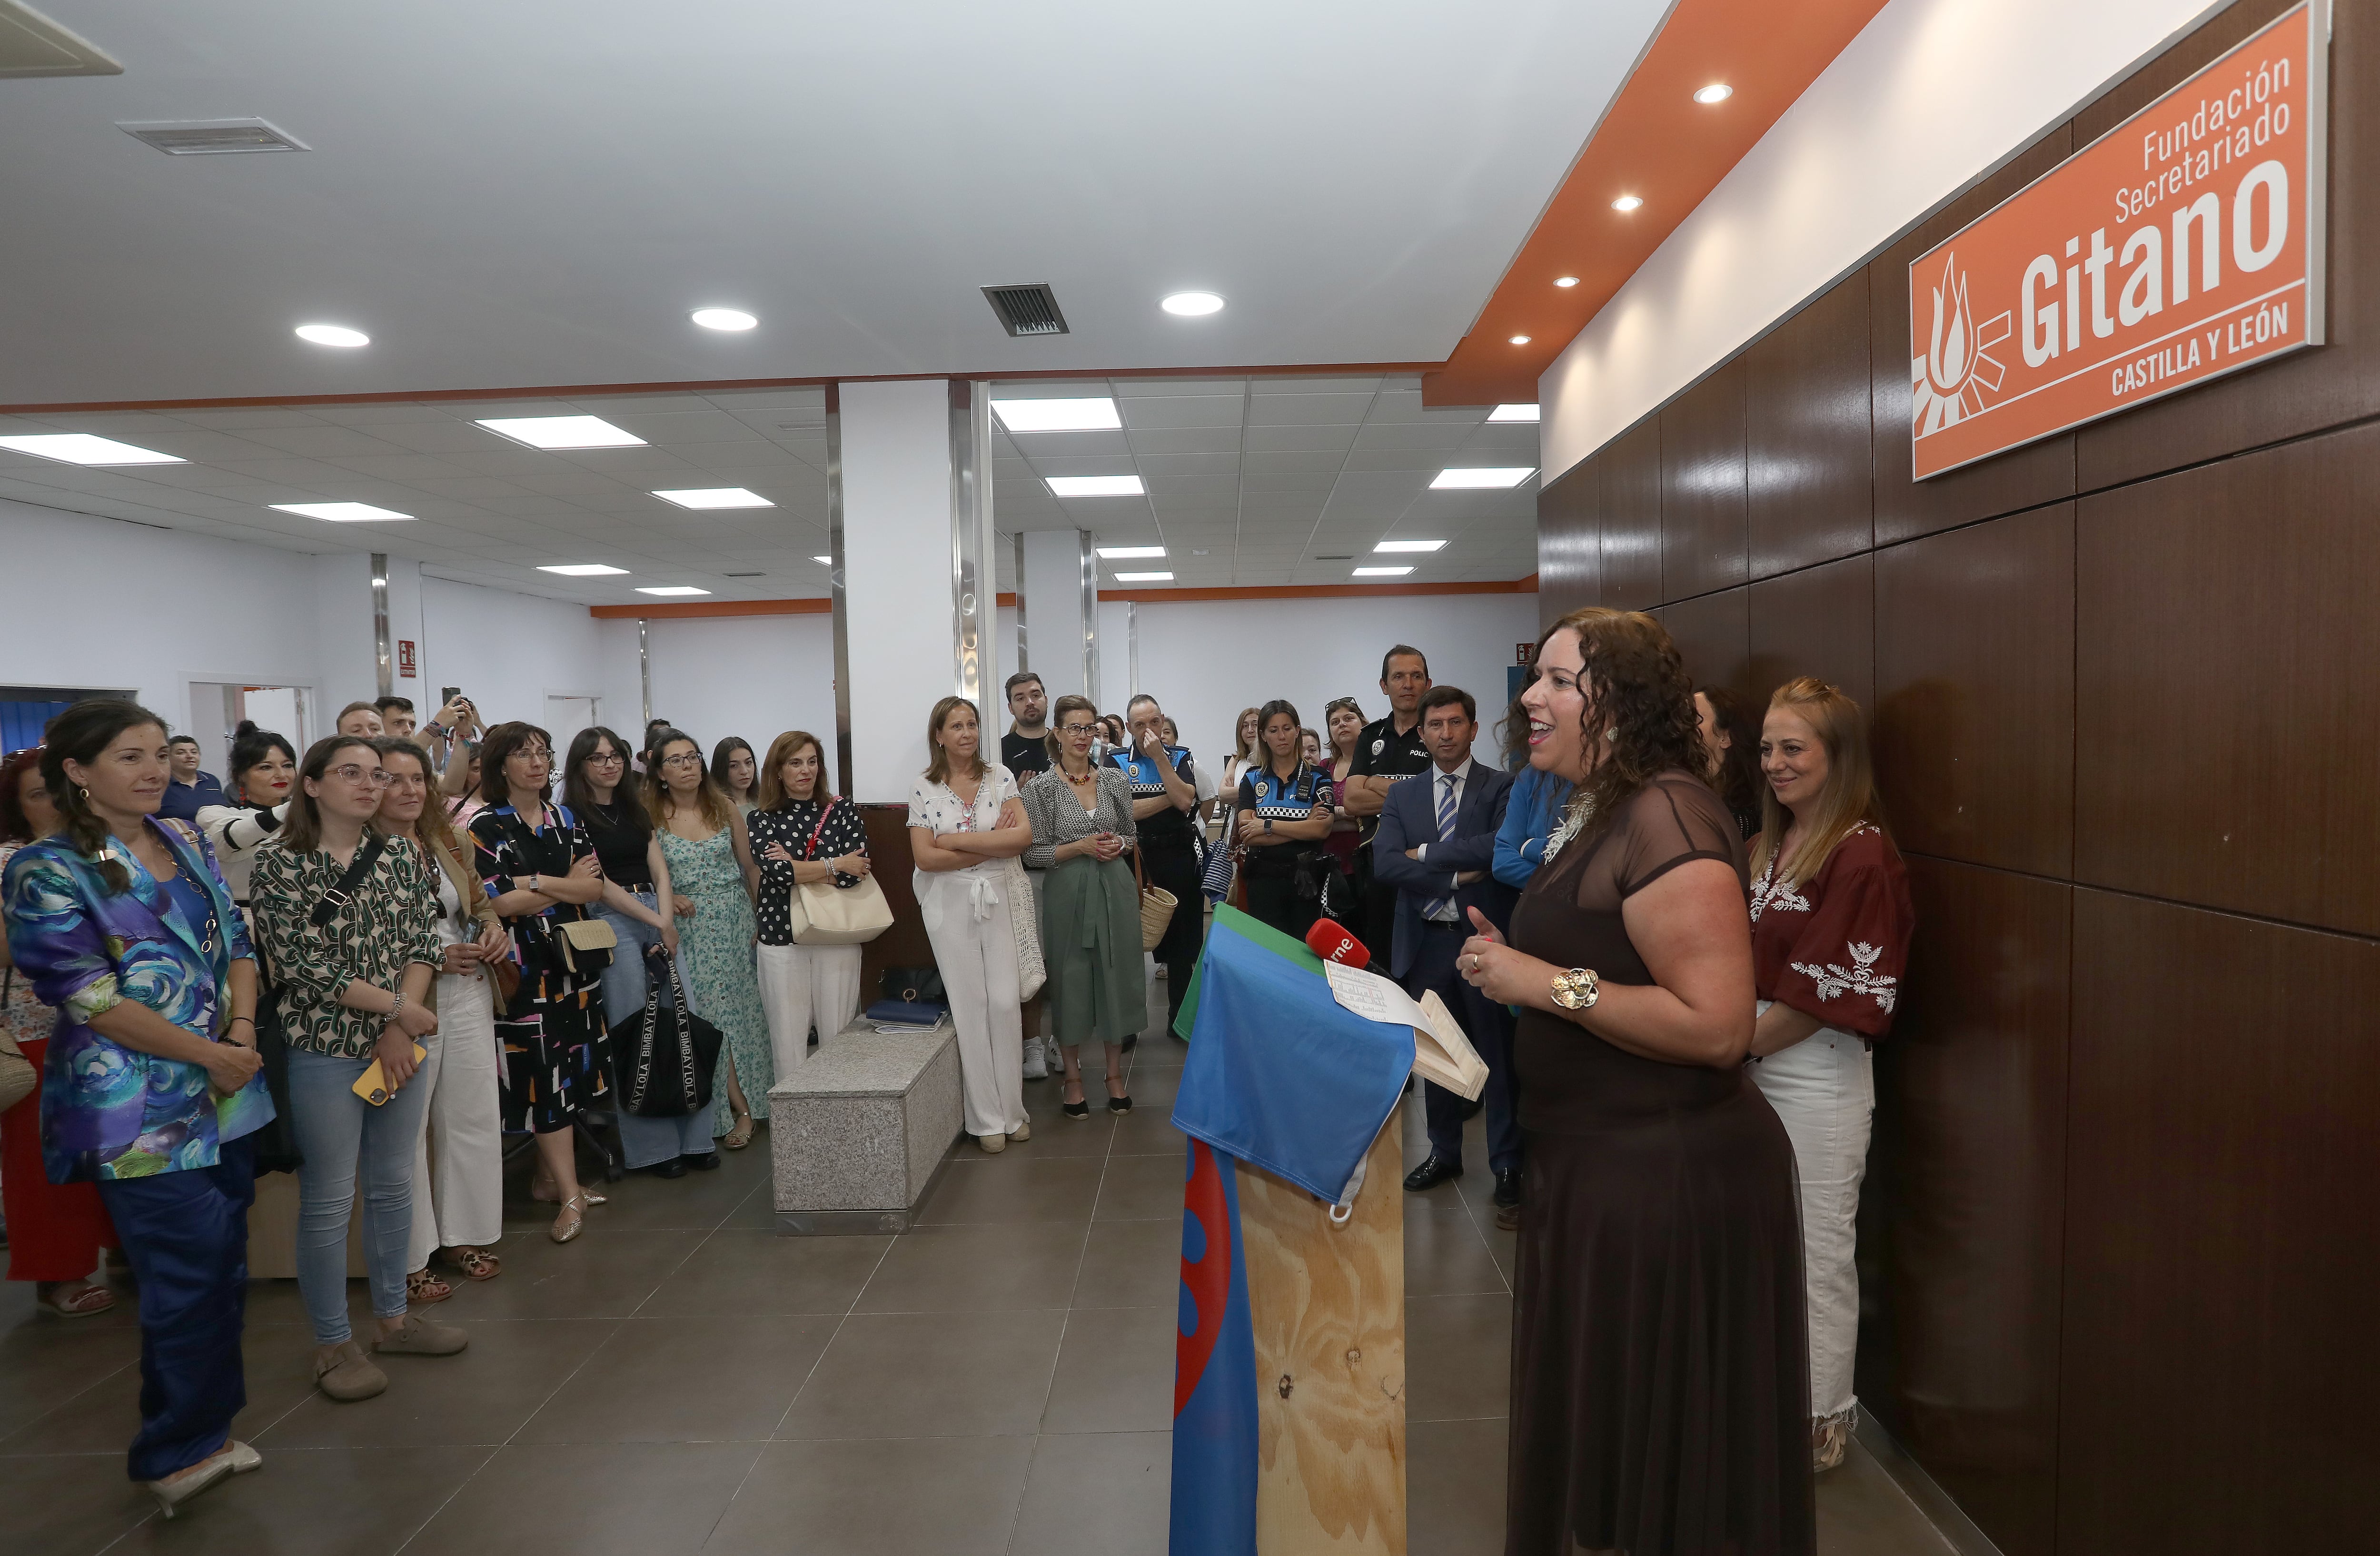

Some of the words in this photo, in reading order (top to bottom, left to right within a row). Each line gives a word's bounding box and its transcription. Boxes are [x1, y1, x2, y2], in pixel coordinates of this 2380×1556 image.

[2116, 103, 2290, 223] Secretariado
[2144, 58, 2290, 170] Fundación
[2022, 160, 2289, 368] Gitano
[2112, 338, 2201, 396] CASTILLA
[2207, 328, 2221, 360] Y
[2228, 302, 2288, 354] LEÓN
[1409, 750, 1429, 758] POLIC
[1330, 938, 1353, 962] rne
[636, 1063, 649, 1089] LOLA
[647, 991, 659, 1016] LOLA
[675, 1000, 687, 1026] LOLA
[684, 1071, 694, 1098] LOLA
